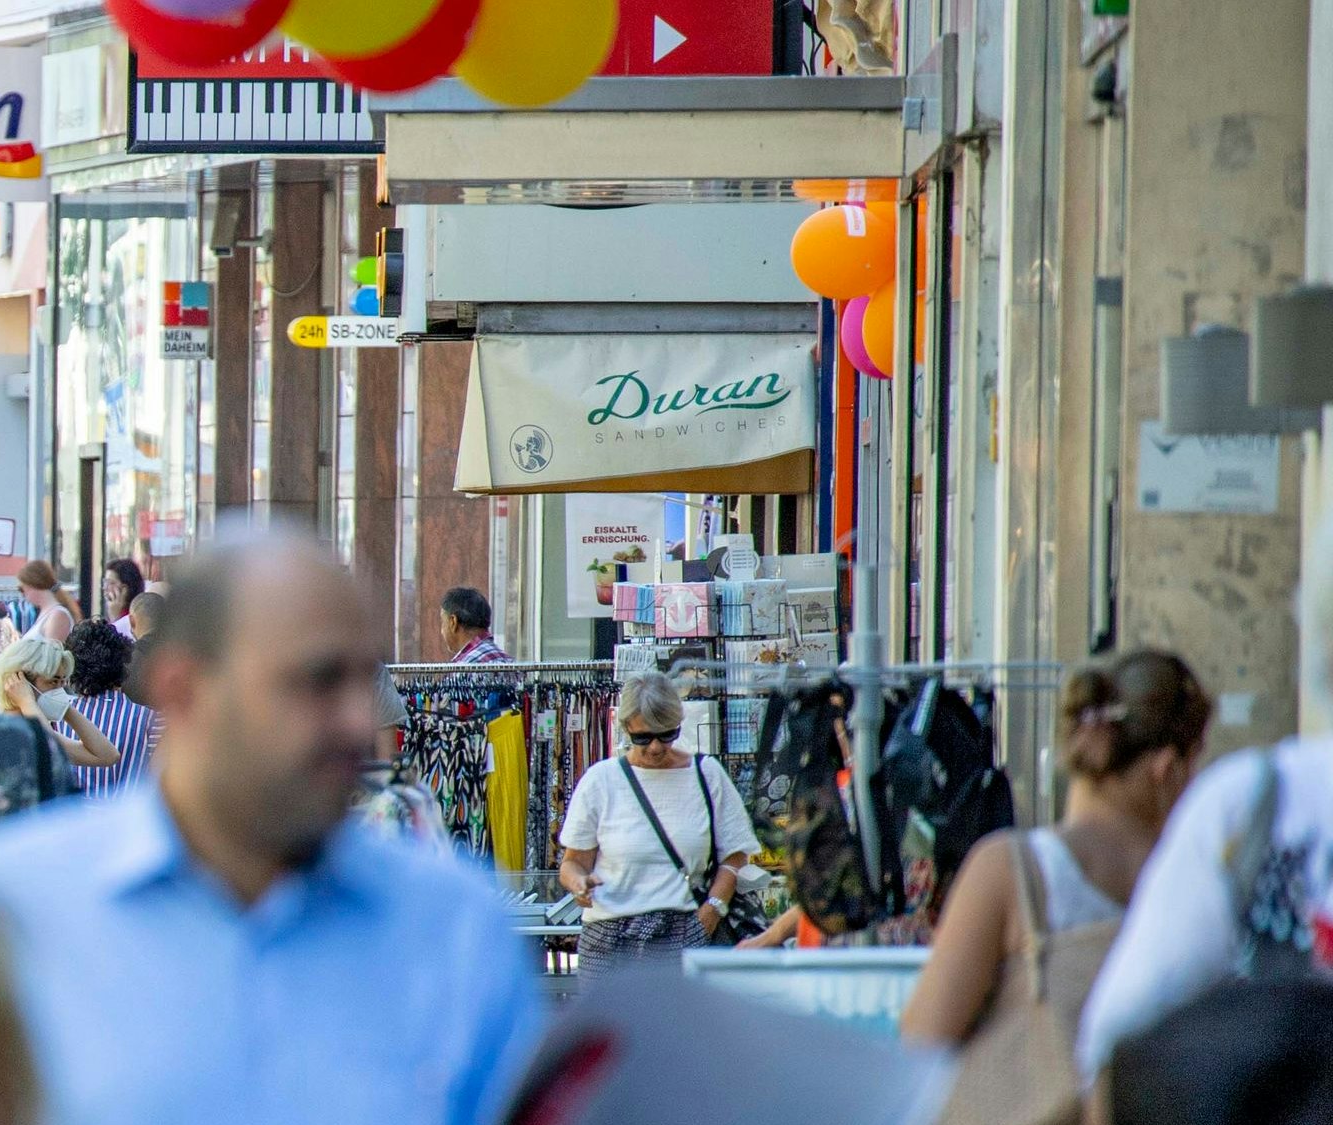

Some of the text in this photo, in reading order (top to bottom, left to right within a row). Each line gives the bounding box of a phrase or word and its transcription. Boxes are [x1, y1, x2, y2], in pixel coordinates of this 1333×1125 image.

[164, 331, 192, 341] MEIN
[300, 324, 396, 339] 24h SB-ZONE
[164, 342, 206, 352] DAHEIM
[588, 370, 790, 425] Duran
[594, 416, 787, 444] SANDWICHES
[594, 526, 638, 535] EISKALTE
[582, 535, 650, 544] ERFRISCHUNG.
